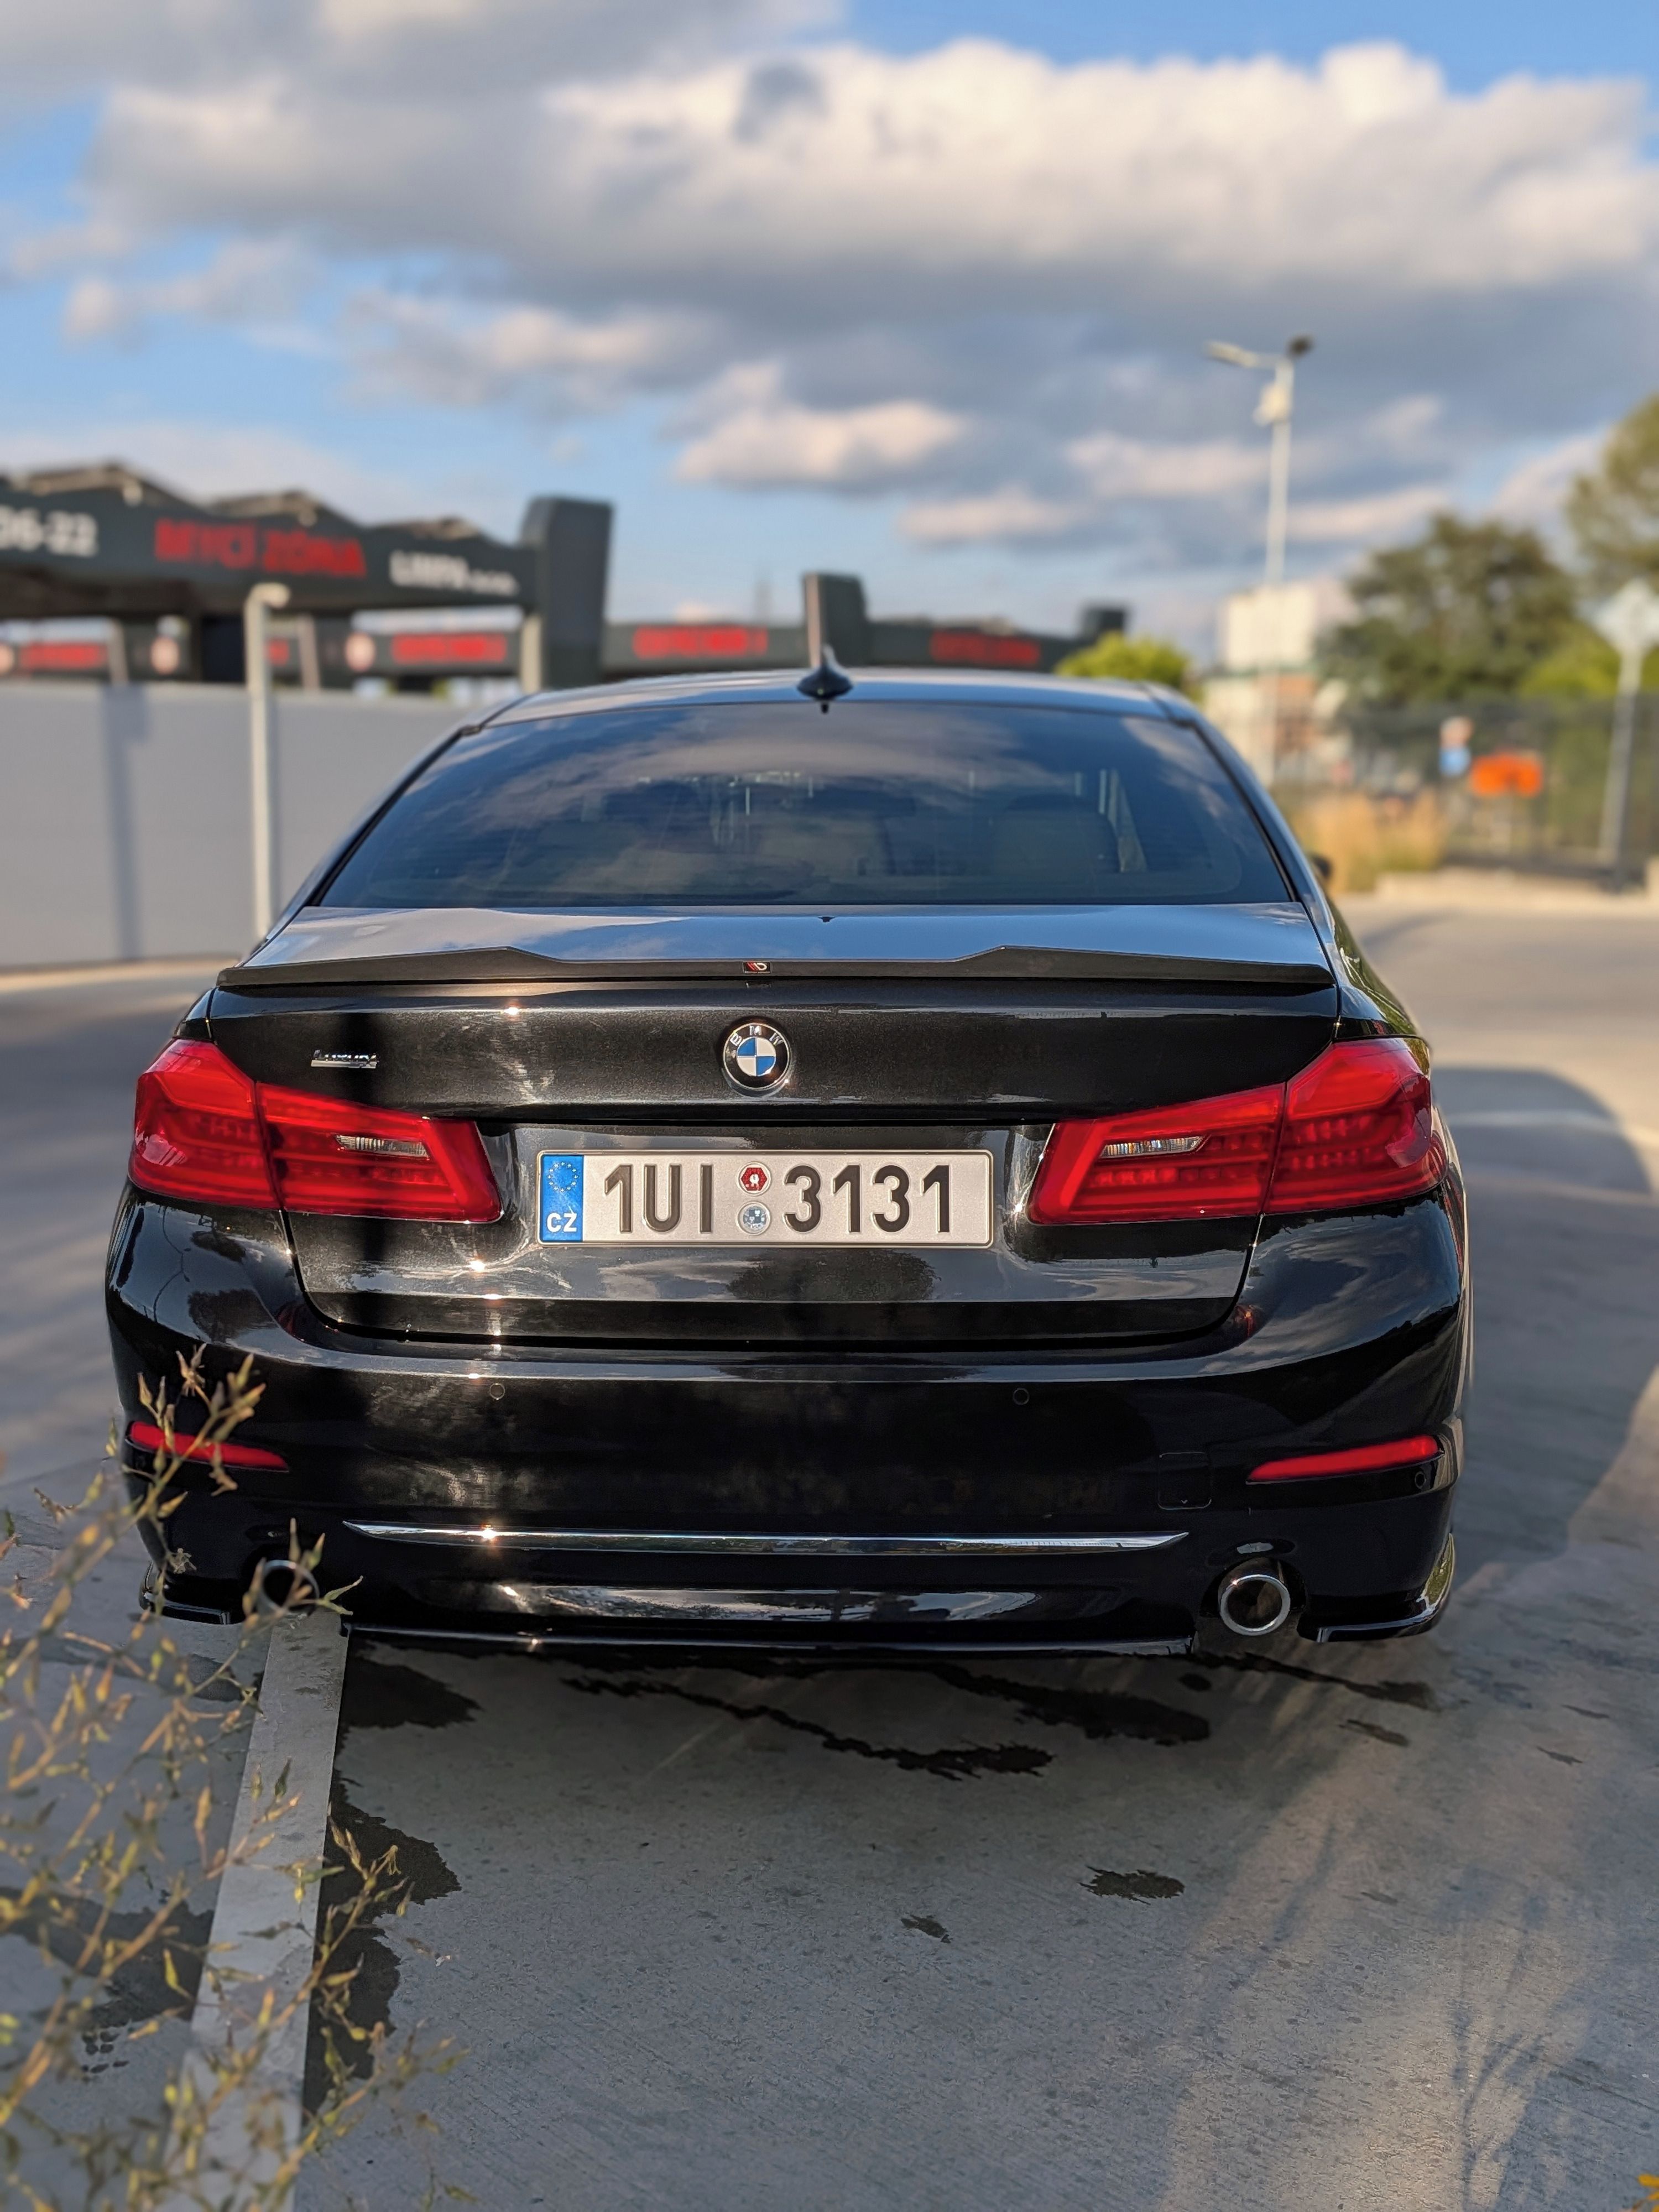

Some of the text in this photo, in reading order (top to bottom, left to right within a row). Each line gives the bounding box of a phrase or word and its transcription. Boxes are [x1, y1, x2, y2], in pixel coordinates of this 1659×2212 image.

[729, 1025, 783, 1046] BMW
[604, 1164, 951, 1234] 1UI 3131
[546, 1212, 577, 1233] CZ
